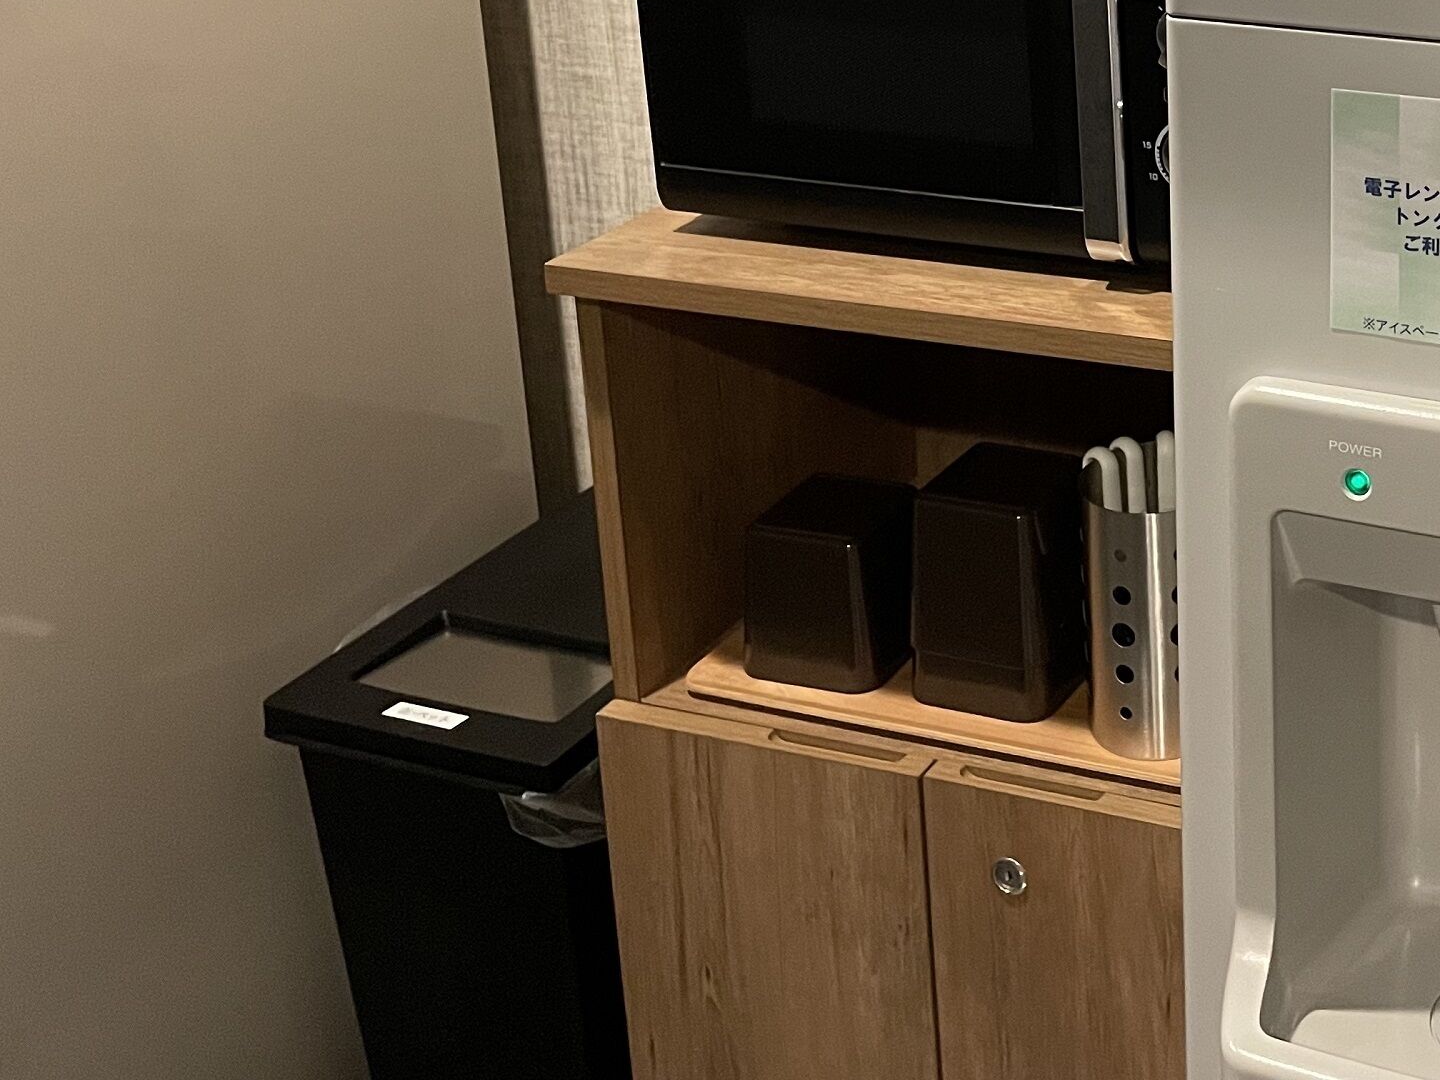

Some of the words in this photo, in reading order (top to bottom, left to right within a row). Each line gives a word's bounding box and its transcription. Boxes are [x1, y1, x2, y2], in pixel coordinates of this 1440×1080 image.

[1142, 140, 1152, 149] 15
[1148, 172, 1159, 181] 10
[1328, 439, 1383, 460] POWER
